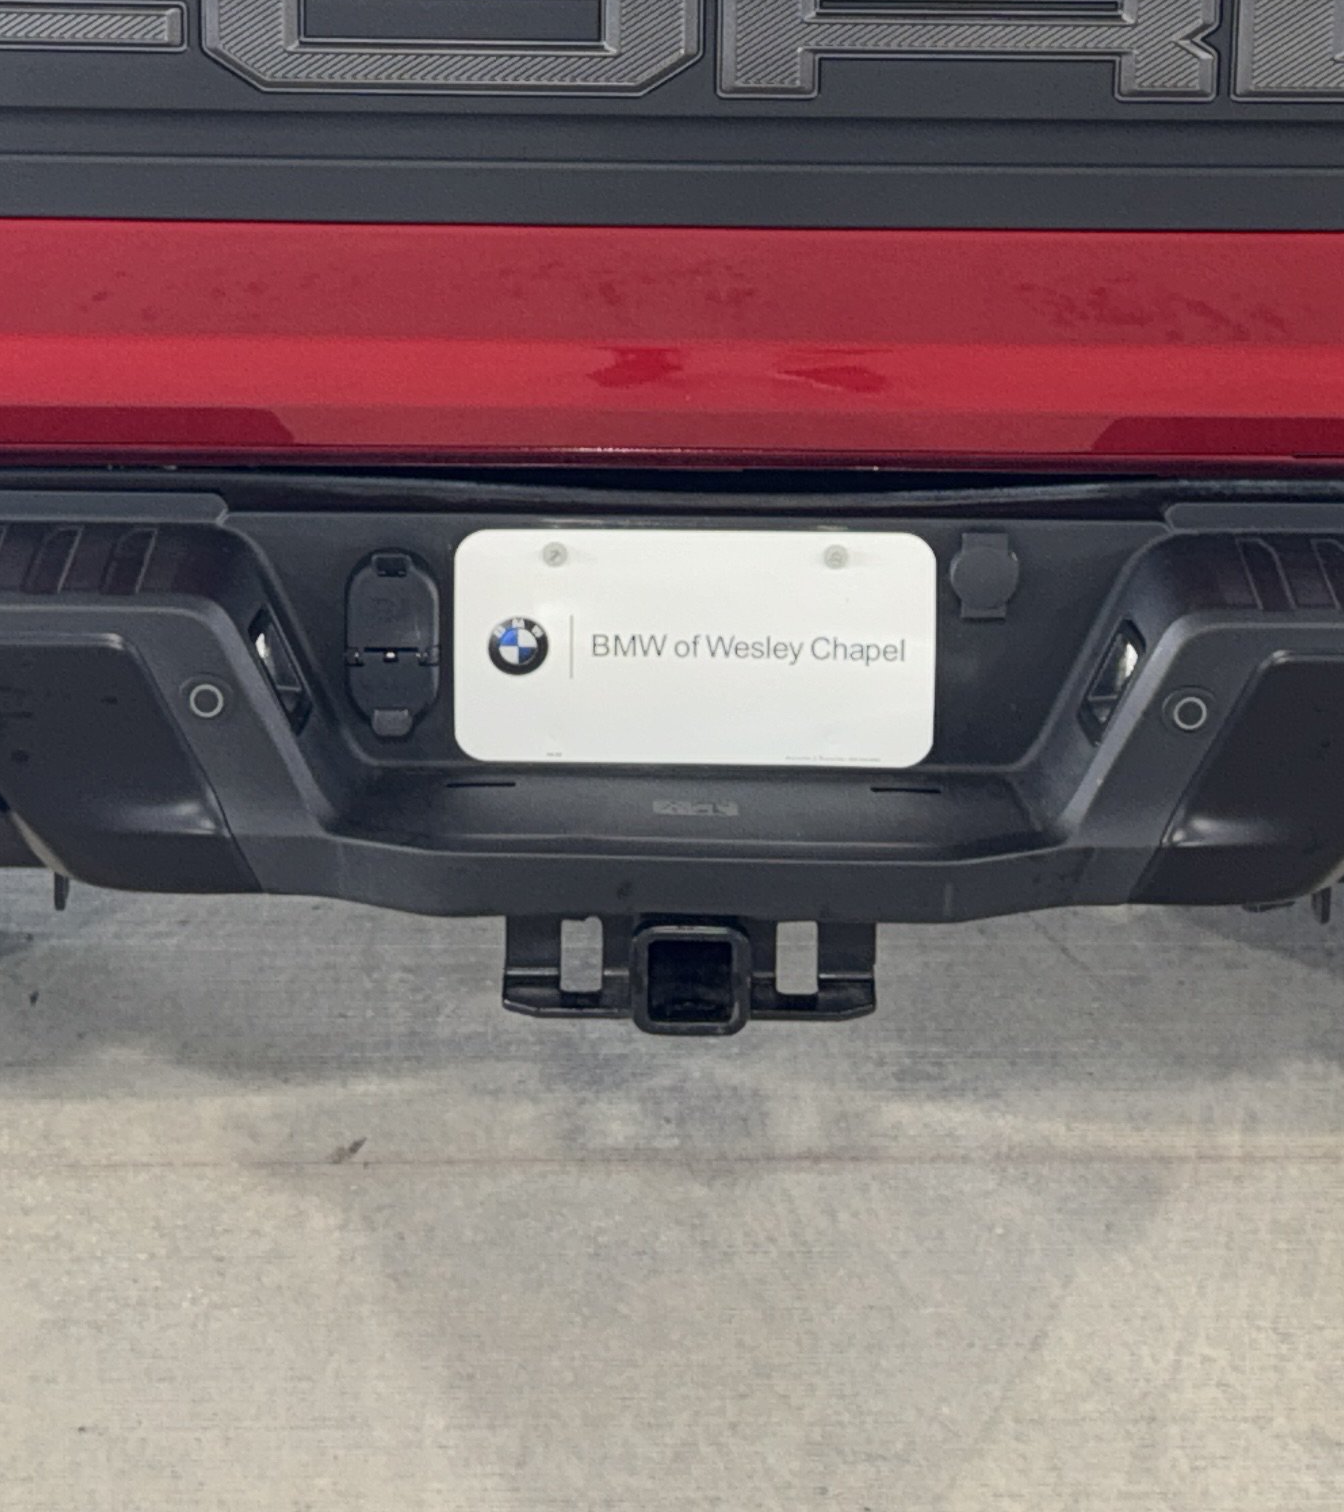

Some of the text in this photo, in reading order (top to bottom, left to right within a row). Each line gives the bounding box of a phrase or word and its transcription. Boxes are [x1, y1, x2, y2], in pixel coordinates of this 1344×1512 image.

[592, 634, 905, 667] BMW of Wesley Chapel
